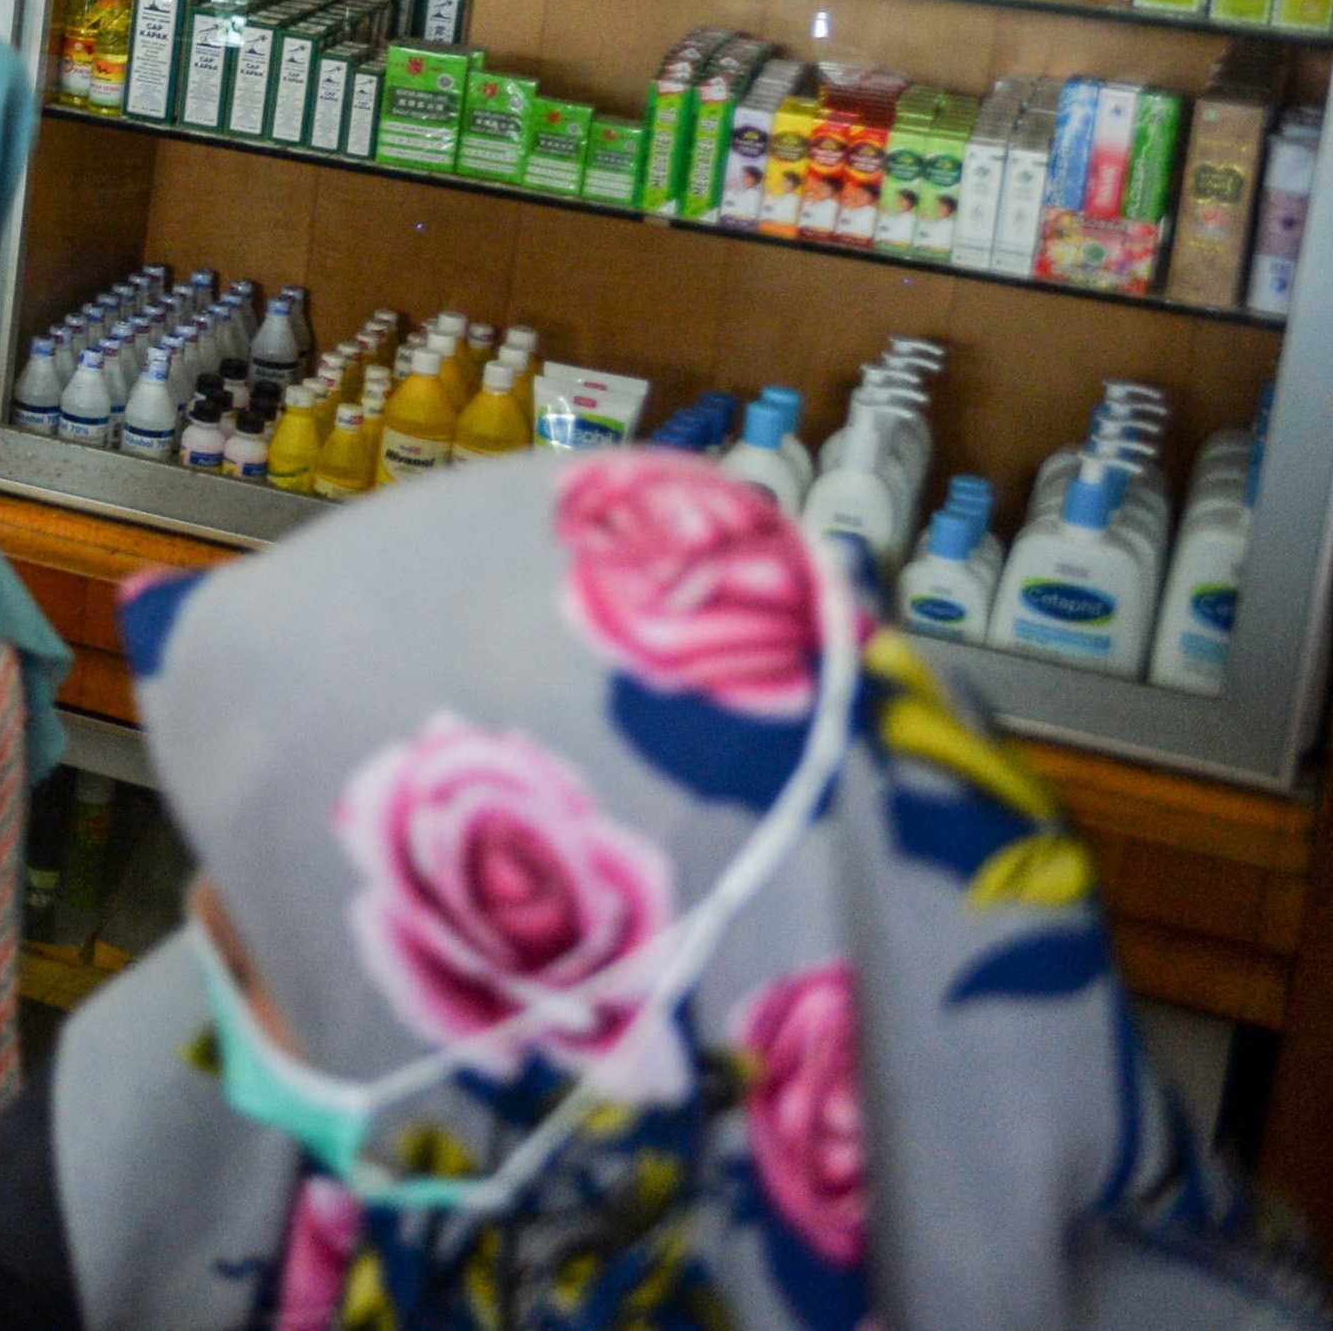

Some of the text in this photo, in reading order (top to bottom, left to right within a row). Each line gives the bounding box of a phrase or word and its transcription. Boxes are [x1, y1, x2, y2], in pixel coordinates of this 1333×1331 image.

[145, 22, 163, 32] CAP
[139, 30, 169, 41] KAPAK
[1027, 585, 1103, 617] Cetaphil
